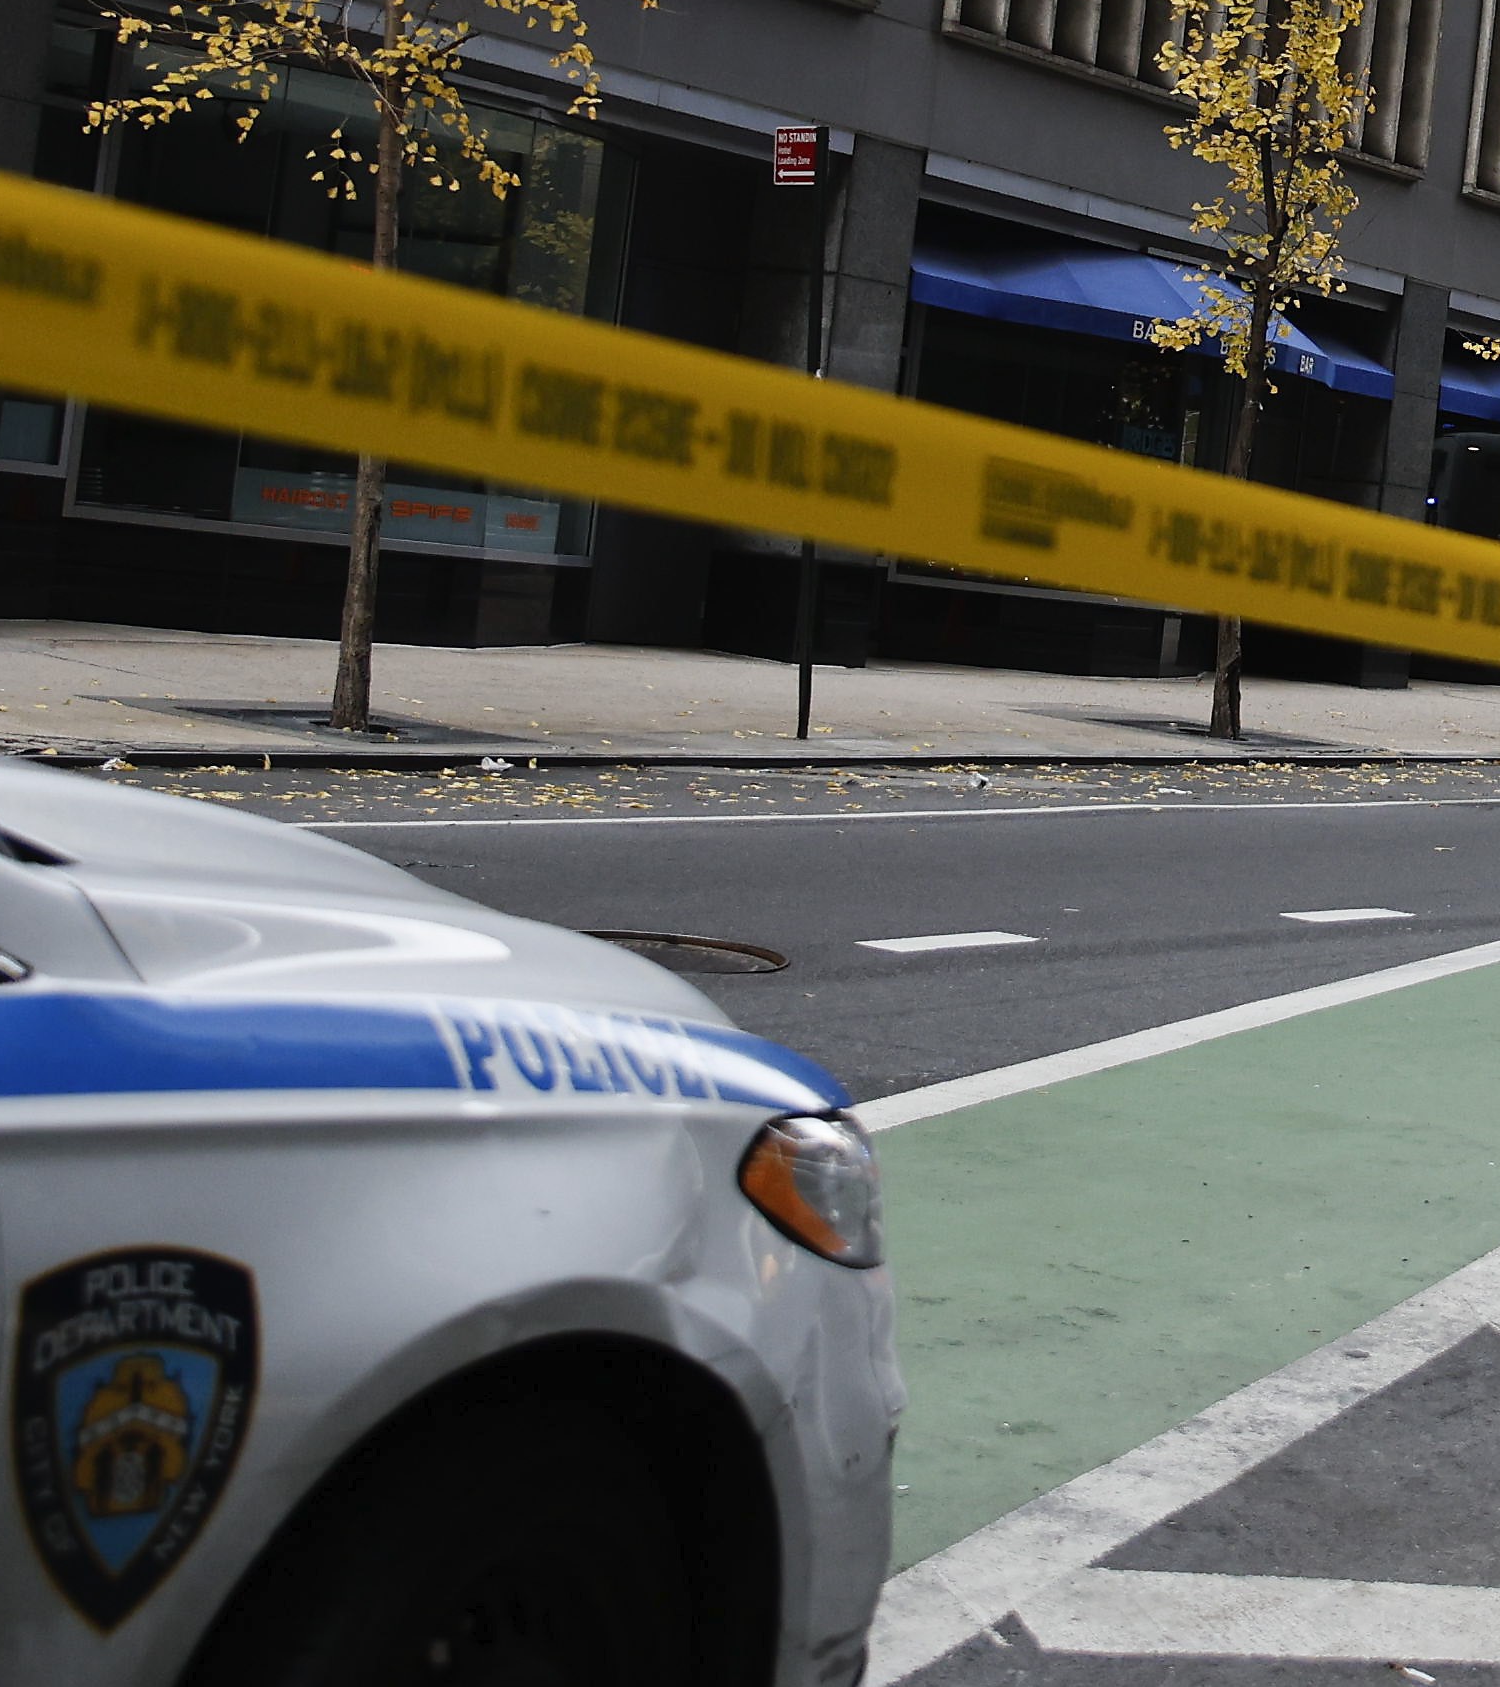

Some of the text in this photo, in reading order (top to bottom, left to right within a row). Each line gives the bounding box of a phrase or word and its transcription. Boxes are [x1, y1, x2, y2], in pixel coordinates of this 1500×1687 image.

[789, 133, 817, 143] STANDIN
[1300, 355, 1315, 374] BAR
[261, 488, 350, 510] HAIRCUT
[84, 1260, 197, 1304] POLICE
[33, 1297, 244, 1373] DEPARTMENT
[204, 1383, 245, 1469] YORK
